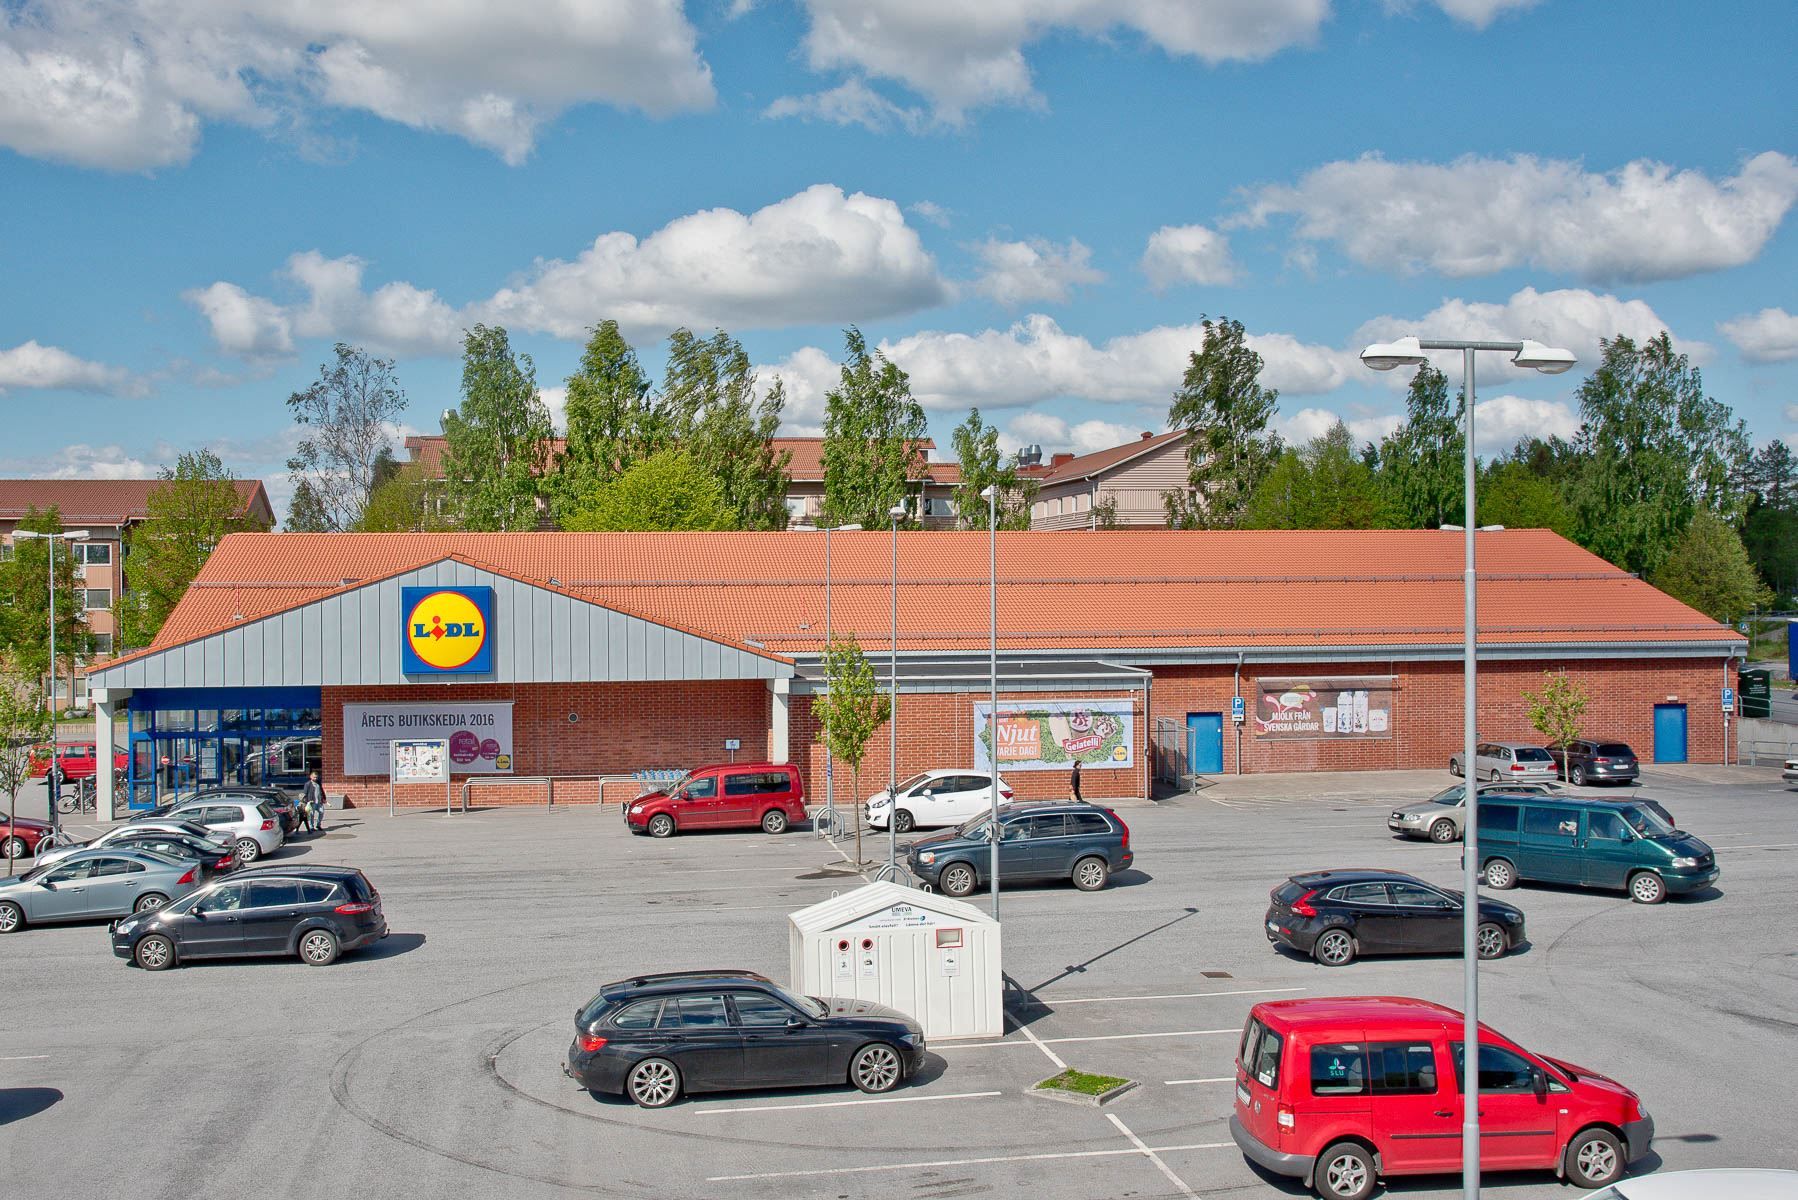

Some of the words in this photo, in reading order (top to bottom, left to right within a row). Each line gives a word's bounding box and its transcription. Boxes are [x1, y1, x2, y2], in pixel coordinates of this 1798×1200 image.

[1725, 690, 1731, 699] P
[1235, 698, 1242, 708] P
[361, 712, 394, 728] ÅRETS
[398, 713, 466, 727] BUTIKSKEDJA
[470, 713, 494, 726] 2016
[1294, 709, 1311, 721] FRÅN
[1264, 722, 1293, 732] SVENSKA
[1293, 721, 1319, 731] GÅRDAR
[997, 724, 1038, 746] Njut
[1065, 737, 1099, 751] Gelatelli
[1019, 746, 1038, 756] DAG!
